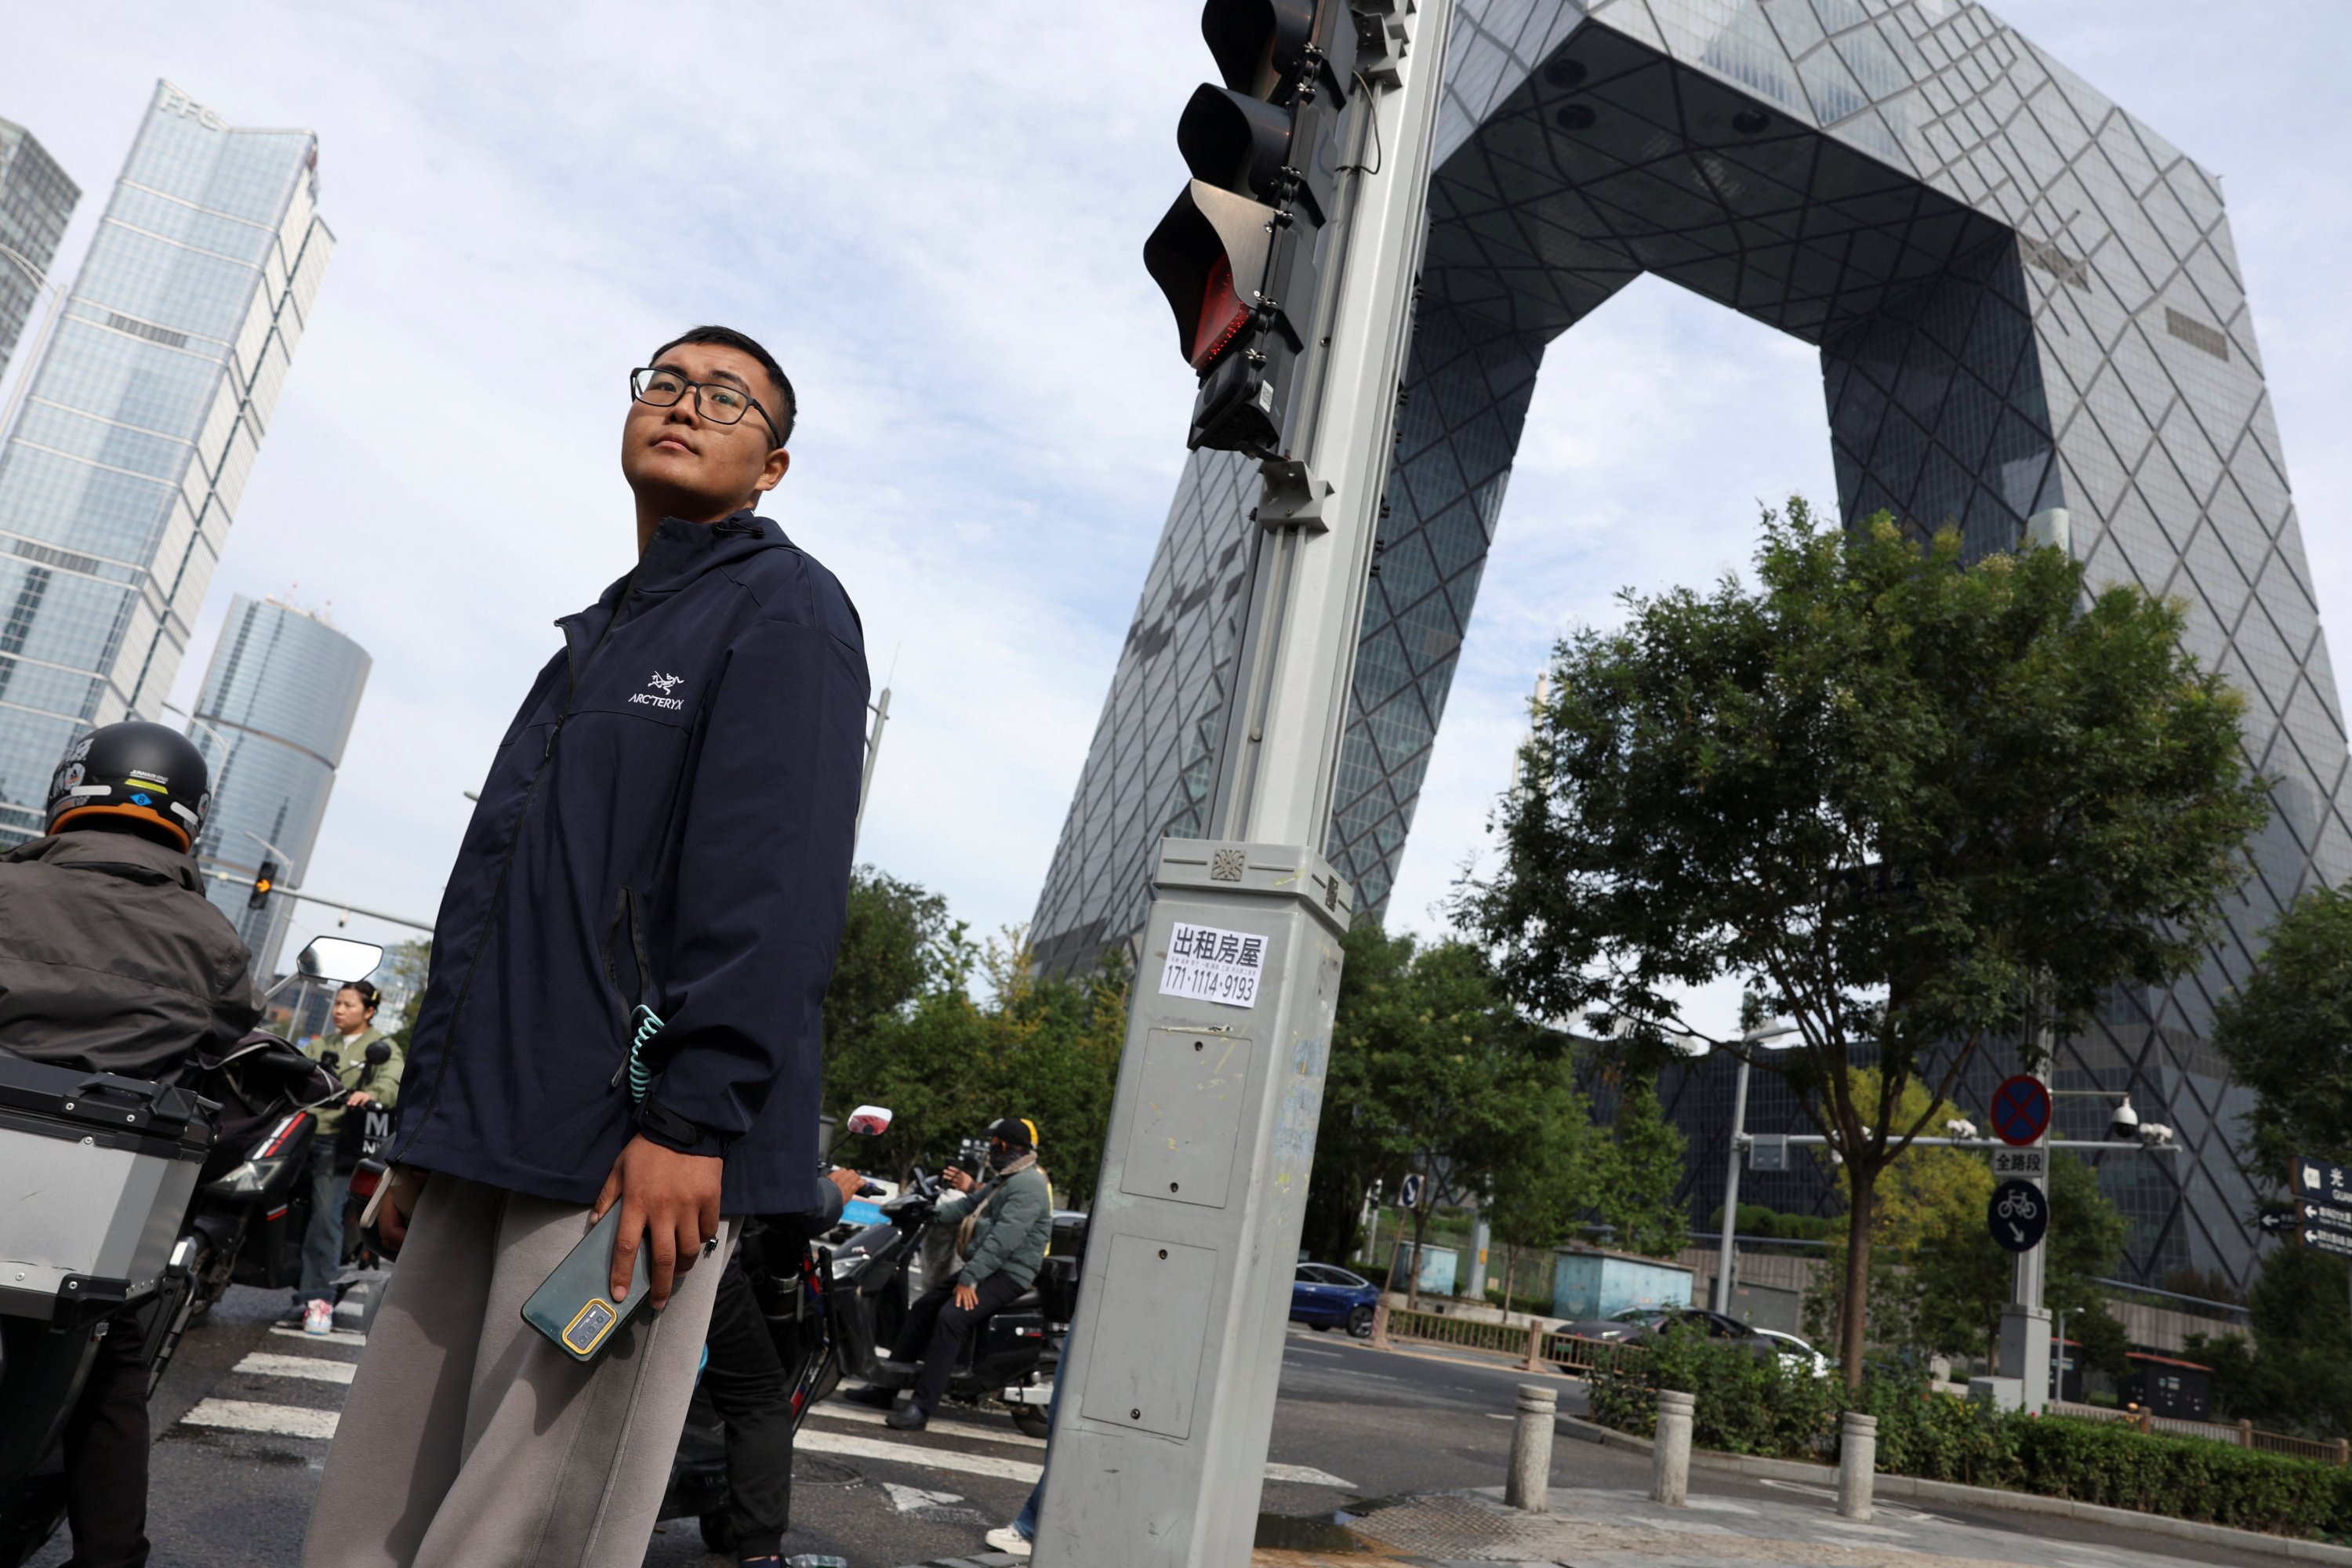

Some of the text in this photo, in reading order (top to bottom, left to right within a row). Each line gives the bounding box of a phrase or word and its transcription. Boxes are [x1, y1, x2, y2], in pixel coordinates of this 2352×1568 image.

[1173, 927, 1262, 968] 出租房屋
[1996, 1153, 2042, 1172] 全路段
